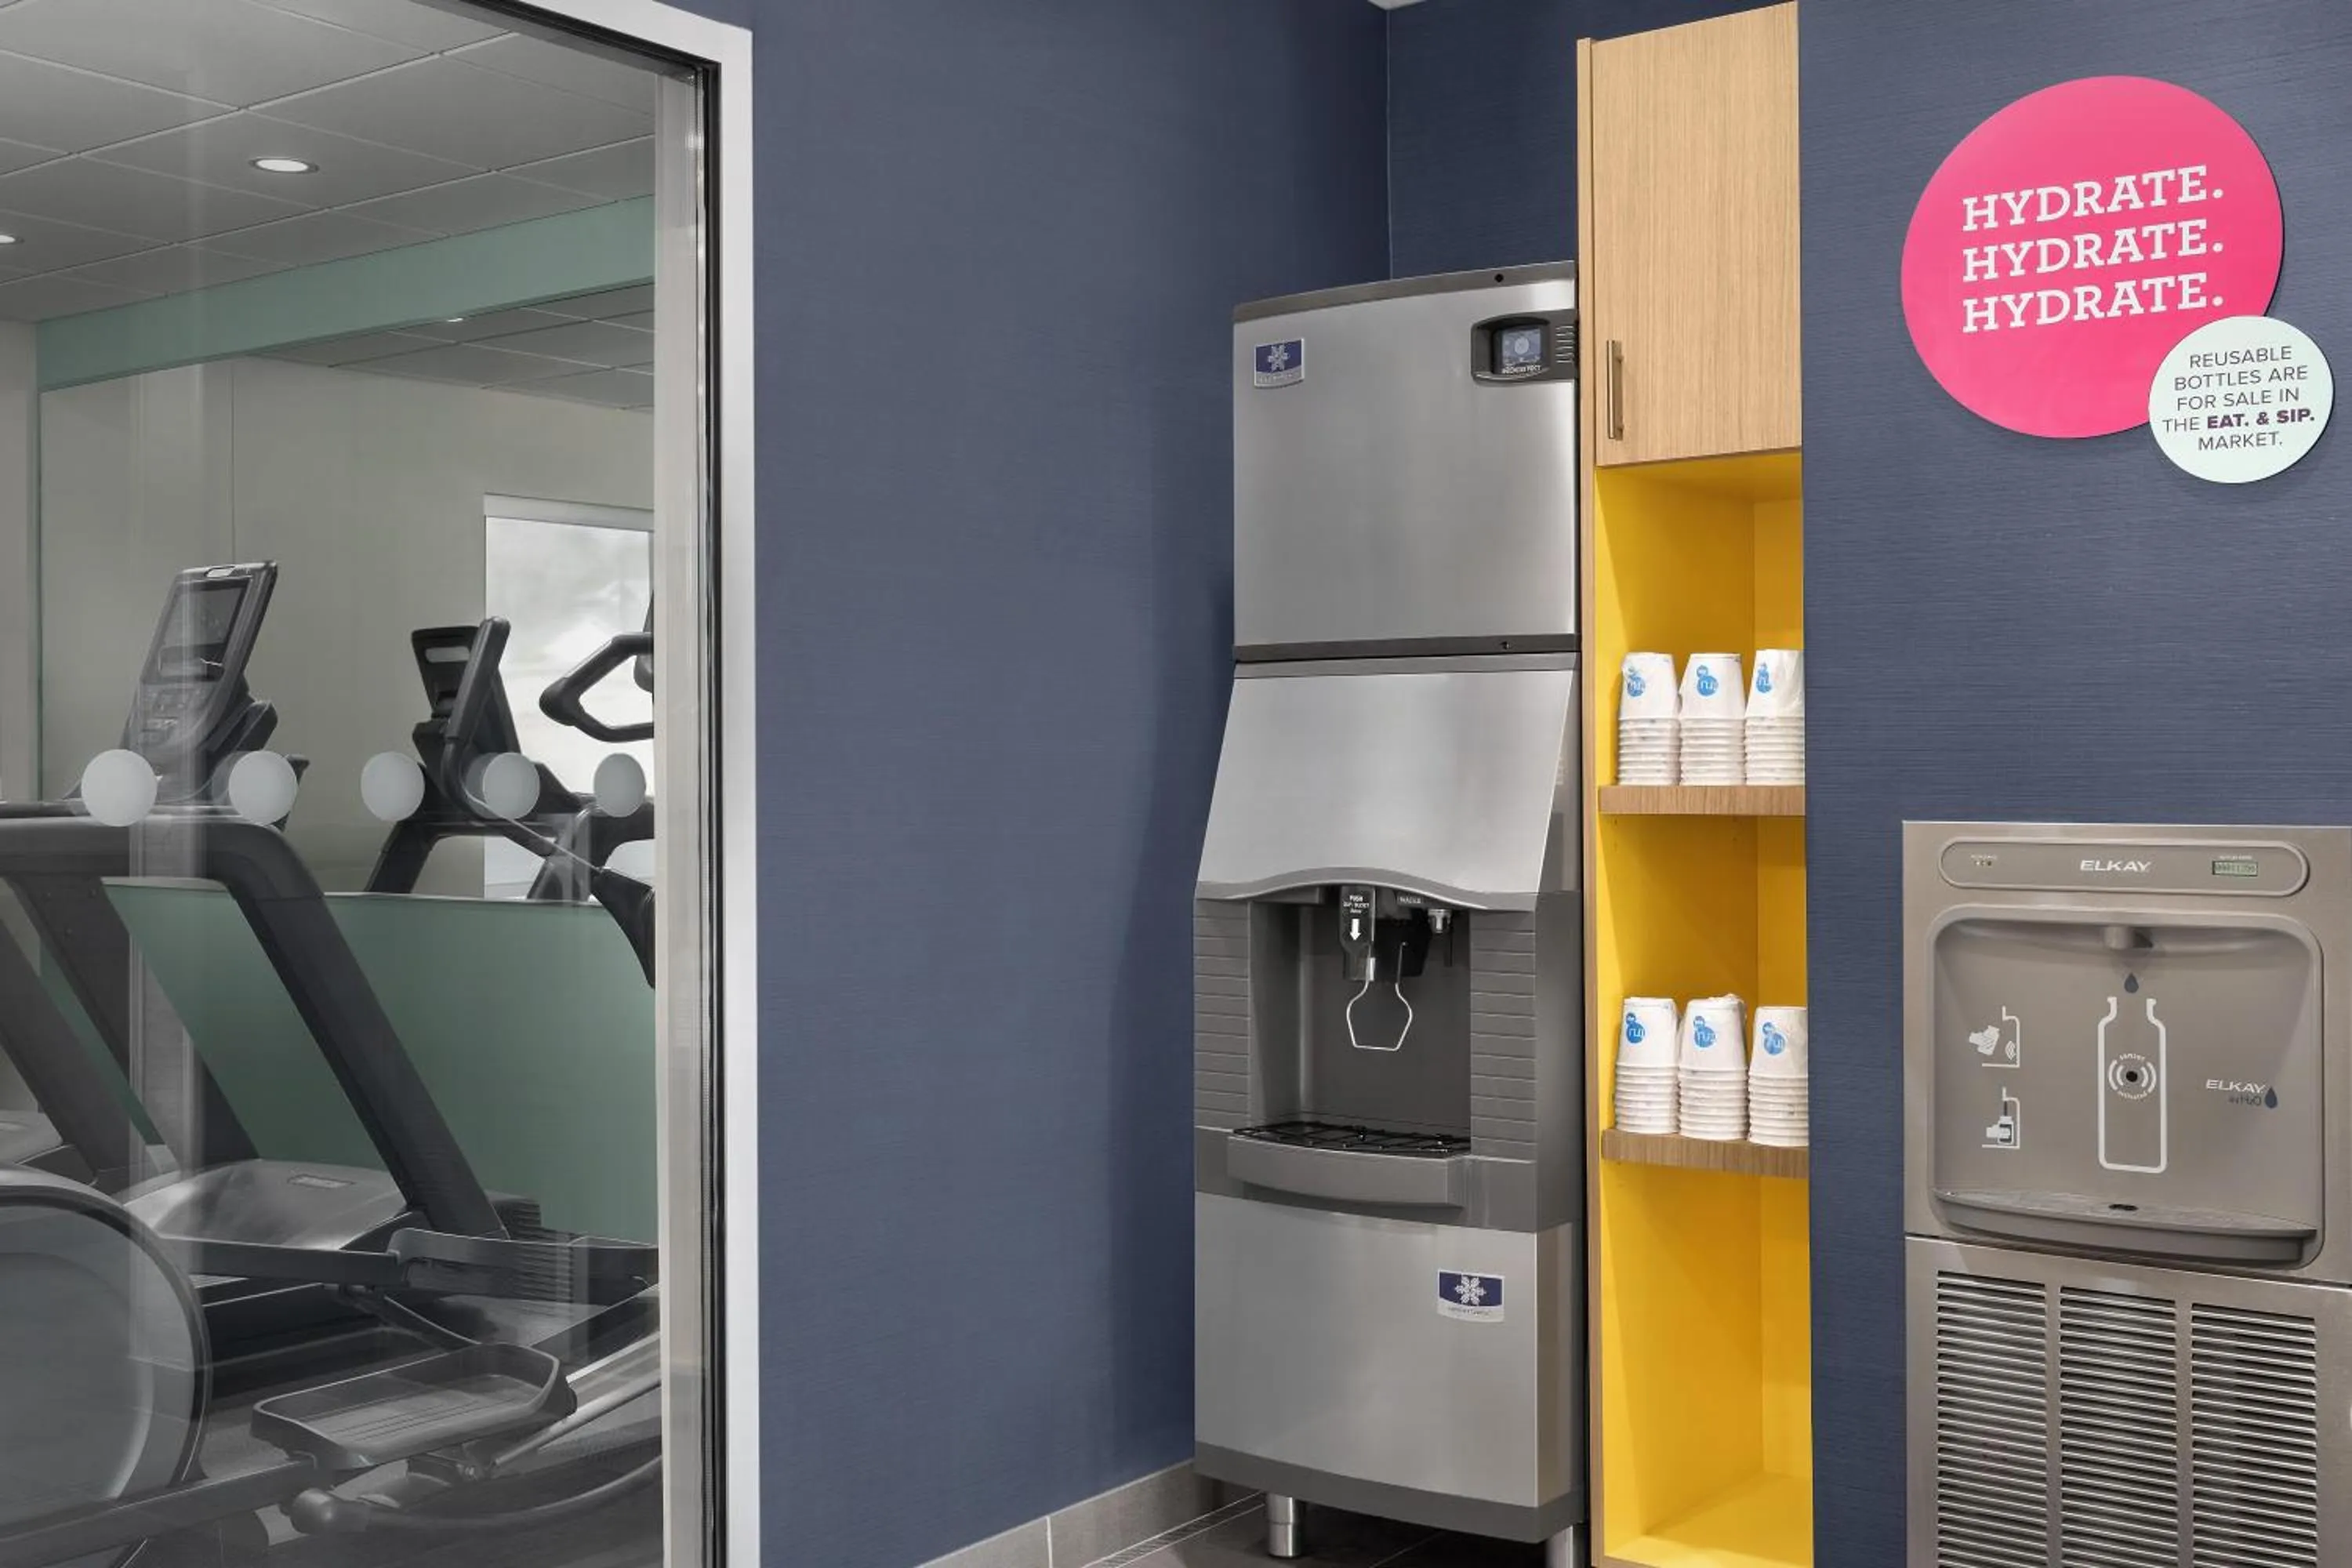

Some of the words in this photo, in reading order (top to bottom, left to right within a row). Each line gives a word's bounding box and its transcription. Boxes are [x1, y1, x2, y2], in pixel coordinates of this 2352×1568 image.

[1962, 165, 2223, 231] HYDRATE.
[1962, 219, 2223, 282] HYDRATE.
[1962, 272, 2223, 333] HYDRATE.
[2189, 346, 2292, 368] REUSABLE
[2174, 369, 2262, 391] BOTTLES
[2268, 365, 2309, 383] ARE
[2177, 394, 2216, 412] FOR
[2223, 390, 2271, 407] SALE
[2279, 387, 2299, 402] IN
[2162, 416, 2201, 434] THE
[2207, 413, 2249, 429] EAT.
[2256, 412, 2270, 426] &
[2277, 408, 2315, 424] SIP.
[2198, 431, 2283, 452] MARKET.
[2080, 859, 2151, 873] ELKAY
[2206, 1079, 2266, 1094] ELKAY
